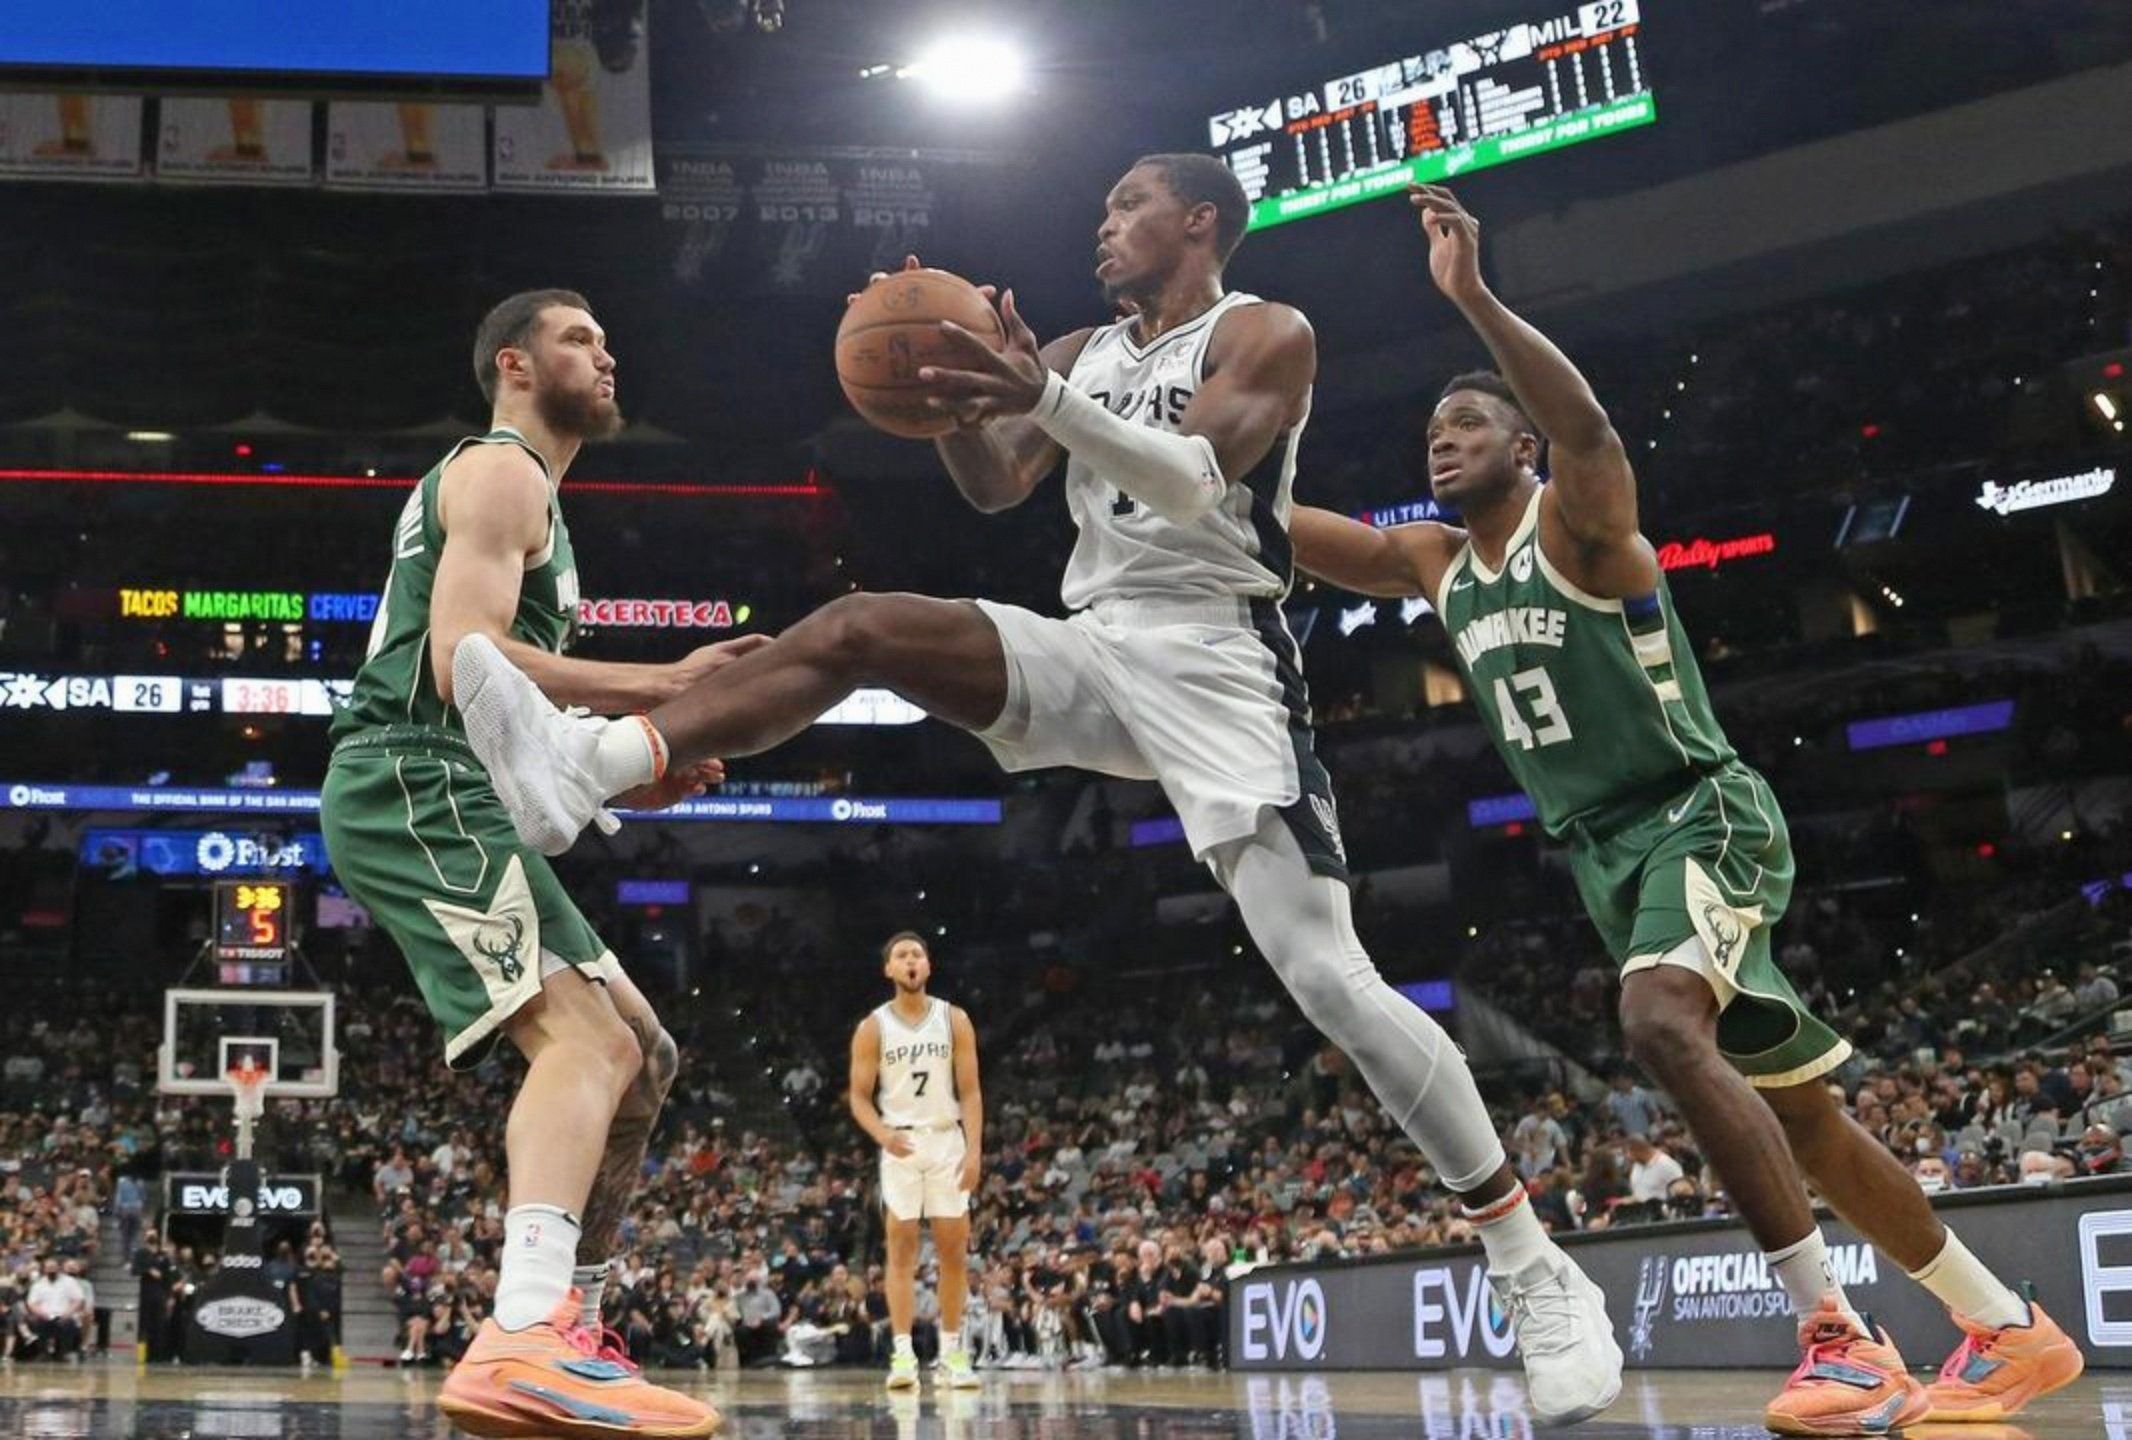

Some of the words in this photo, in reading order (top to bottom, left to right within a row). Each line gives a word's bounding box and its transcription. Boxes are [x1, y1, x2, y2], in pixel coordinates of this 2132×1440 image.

[1595, 0, 1625, 27] 22
[1530, 16, 1581, 47] MIL
[1287, 92, 1320, 116] SA
[1338, 78, 1365, 104] 26
[662, 205, 740, 222] 2007
[759, 205, 840, 223] 2013
[854, 209, 930, 227] 2014
[1374, 501, 1440, 527] ULTRA
[120, 589, 178, 617] TACOS
[183, 591, 304, 619] MARGARITAS
[68, 677, 111, 707] SA
[134, 682, 163, 708] 26
[237, 684, 290, 712] 3:36
[1493, 664, 1574, 751] 43
[695, 803, 737, 815] ANTONIO
[852, 802, 888, 820] Frost
[249, 909, 275, 944] 5
[885, 1041, 950, 1066] SPURS
[911, 1070, 930, 1097] 7
[1672, 1251, 1773, 1294] OFFICIAL
[1242, 1277, 1326, 1361] EVO
[1414, 1263, 1516, 1359] EVO
[1673, 1297, 1701, 1322] SAN
[1699, 1292, 1763, 1321] ANTONIO
[1764, 1290, 1795, 1319] SPU
